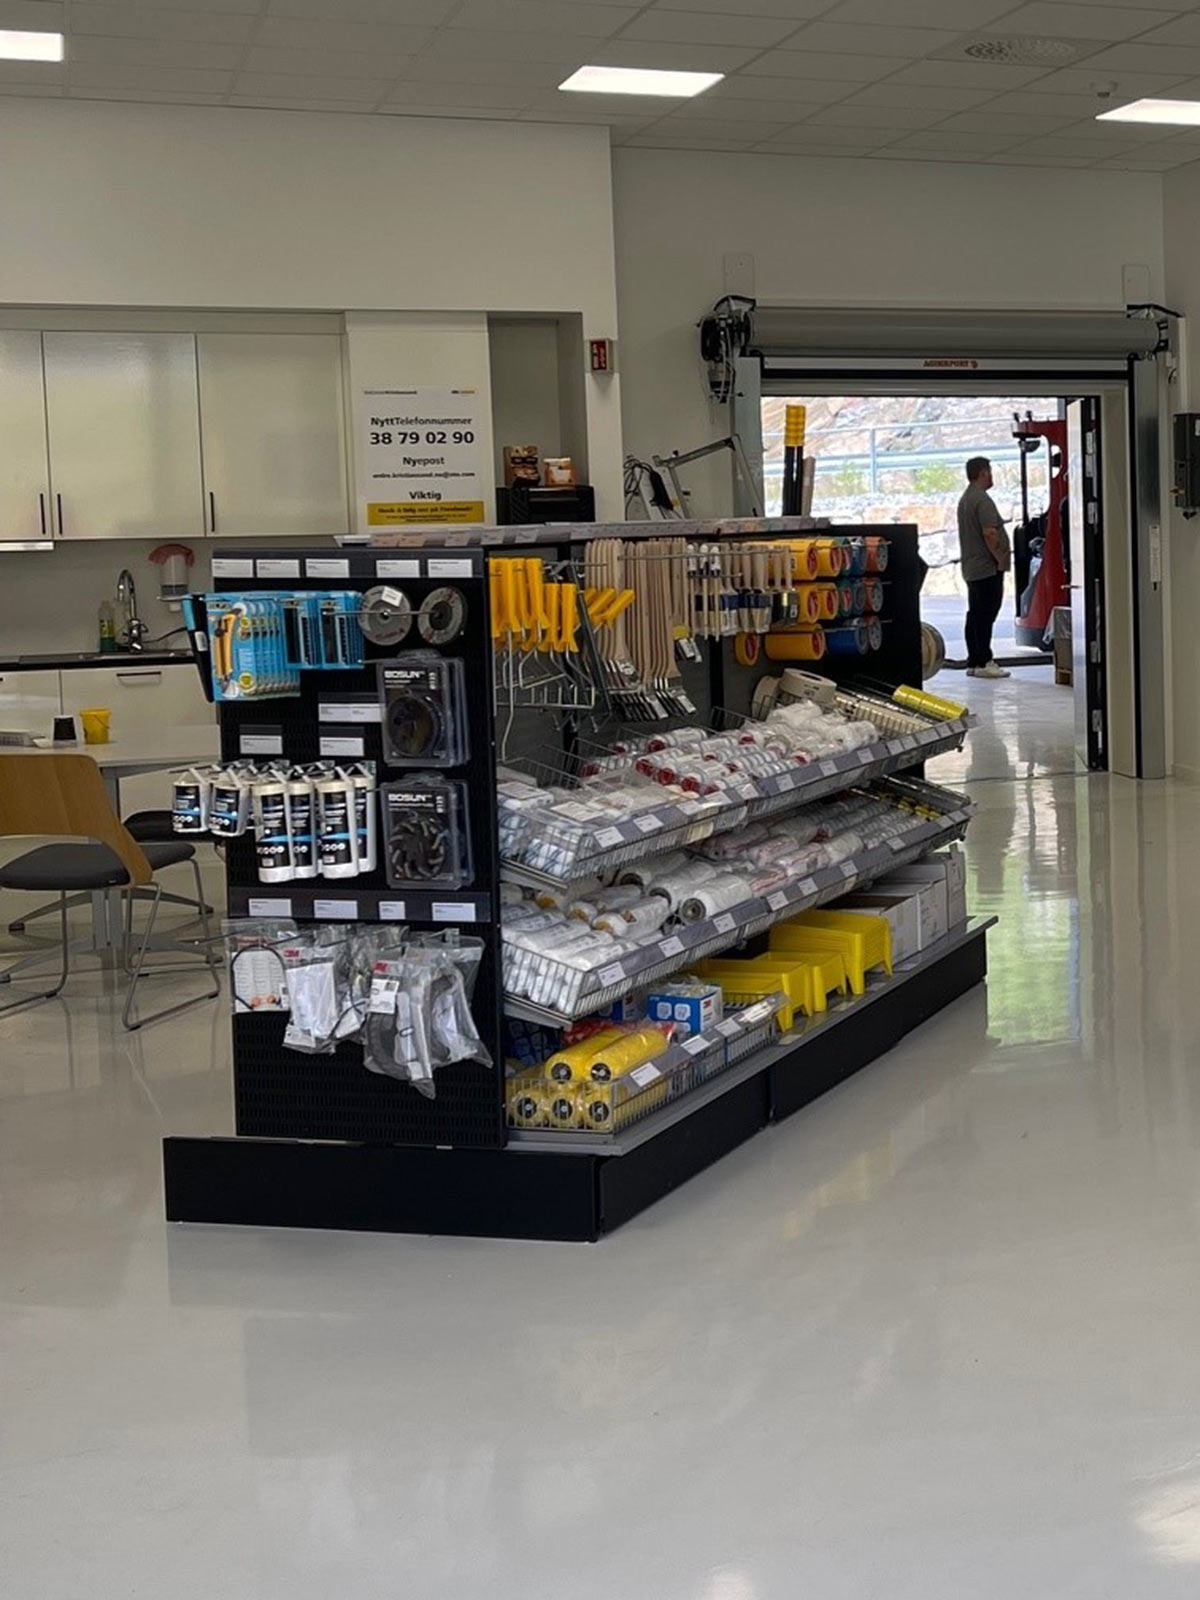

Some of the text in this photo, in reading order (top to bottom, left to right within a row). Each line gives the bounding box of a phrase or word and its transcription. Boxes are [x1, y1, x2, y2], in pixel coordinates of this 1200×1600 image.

[370, 431, 474, 445] 38 79 02 90
[409, 491, 442, 501] Viktig
